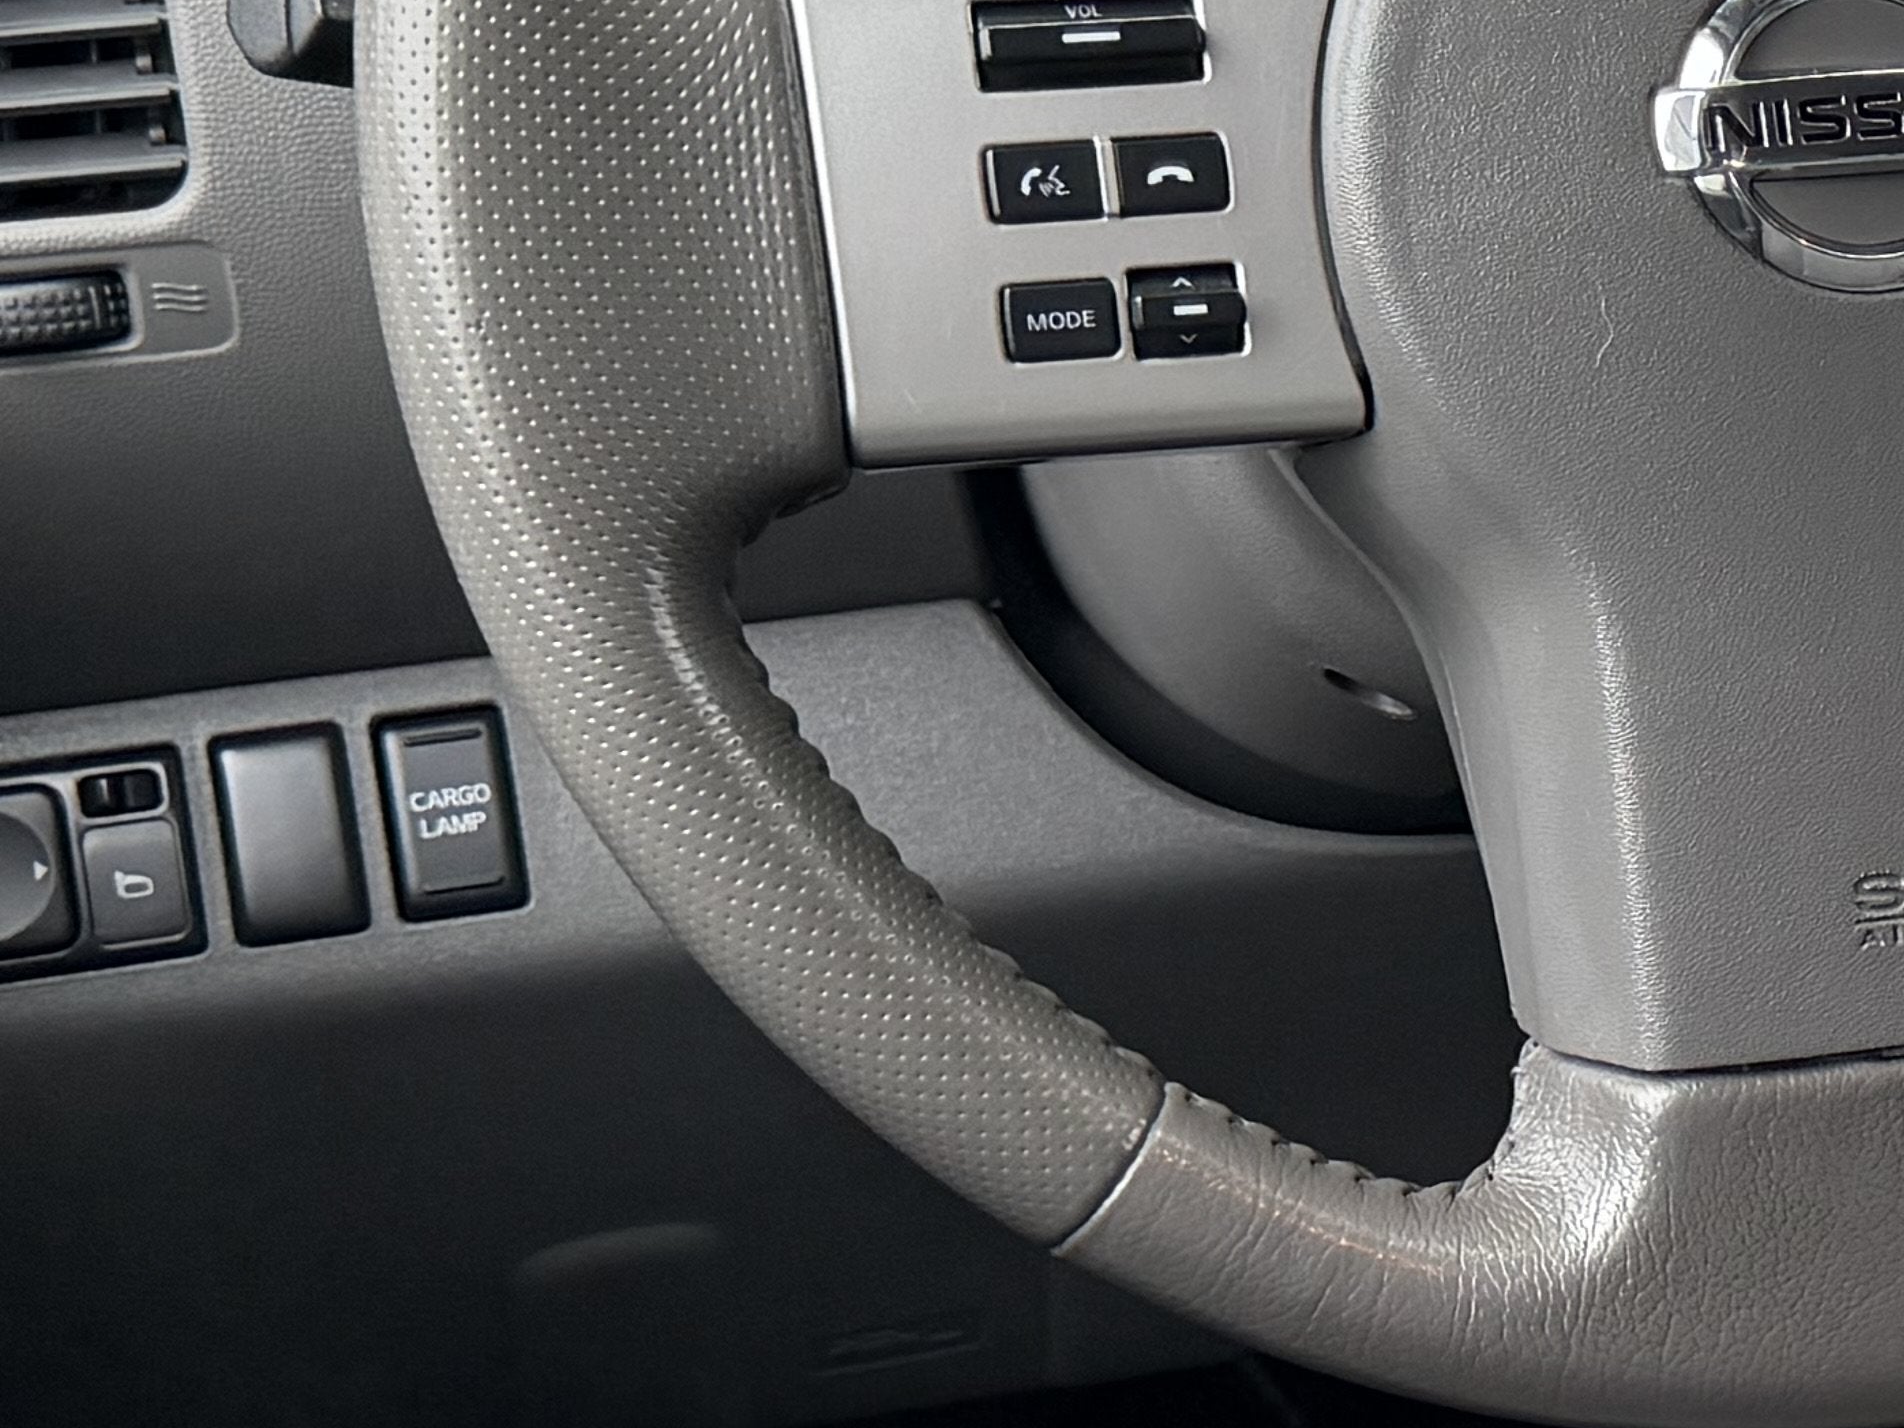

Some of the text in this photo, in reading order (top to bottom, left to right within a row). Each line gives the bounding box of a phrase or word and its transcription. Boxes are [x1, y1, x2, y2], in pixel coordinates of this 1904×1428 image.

[1063, 3, 1103, 20] VOL
[1025, 308, 1097, 333] MODE
[409, 781, 491, 813] CARGO
[419, 810, 487, 840] LAMP
